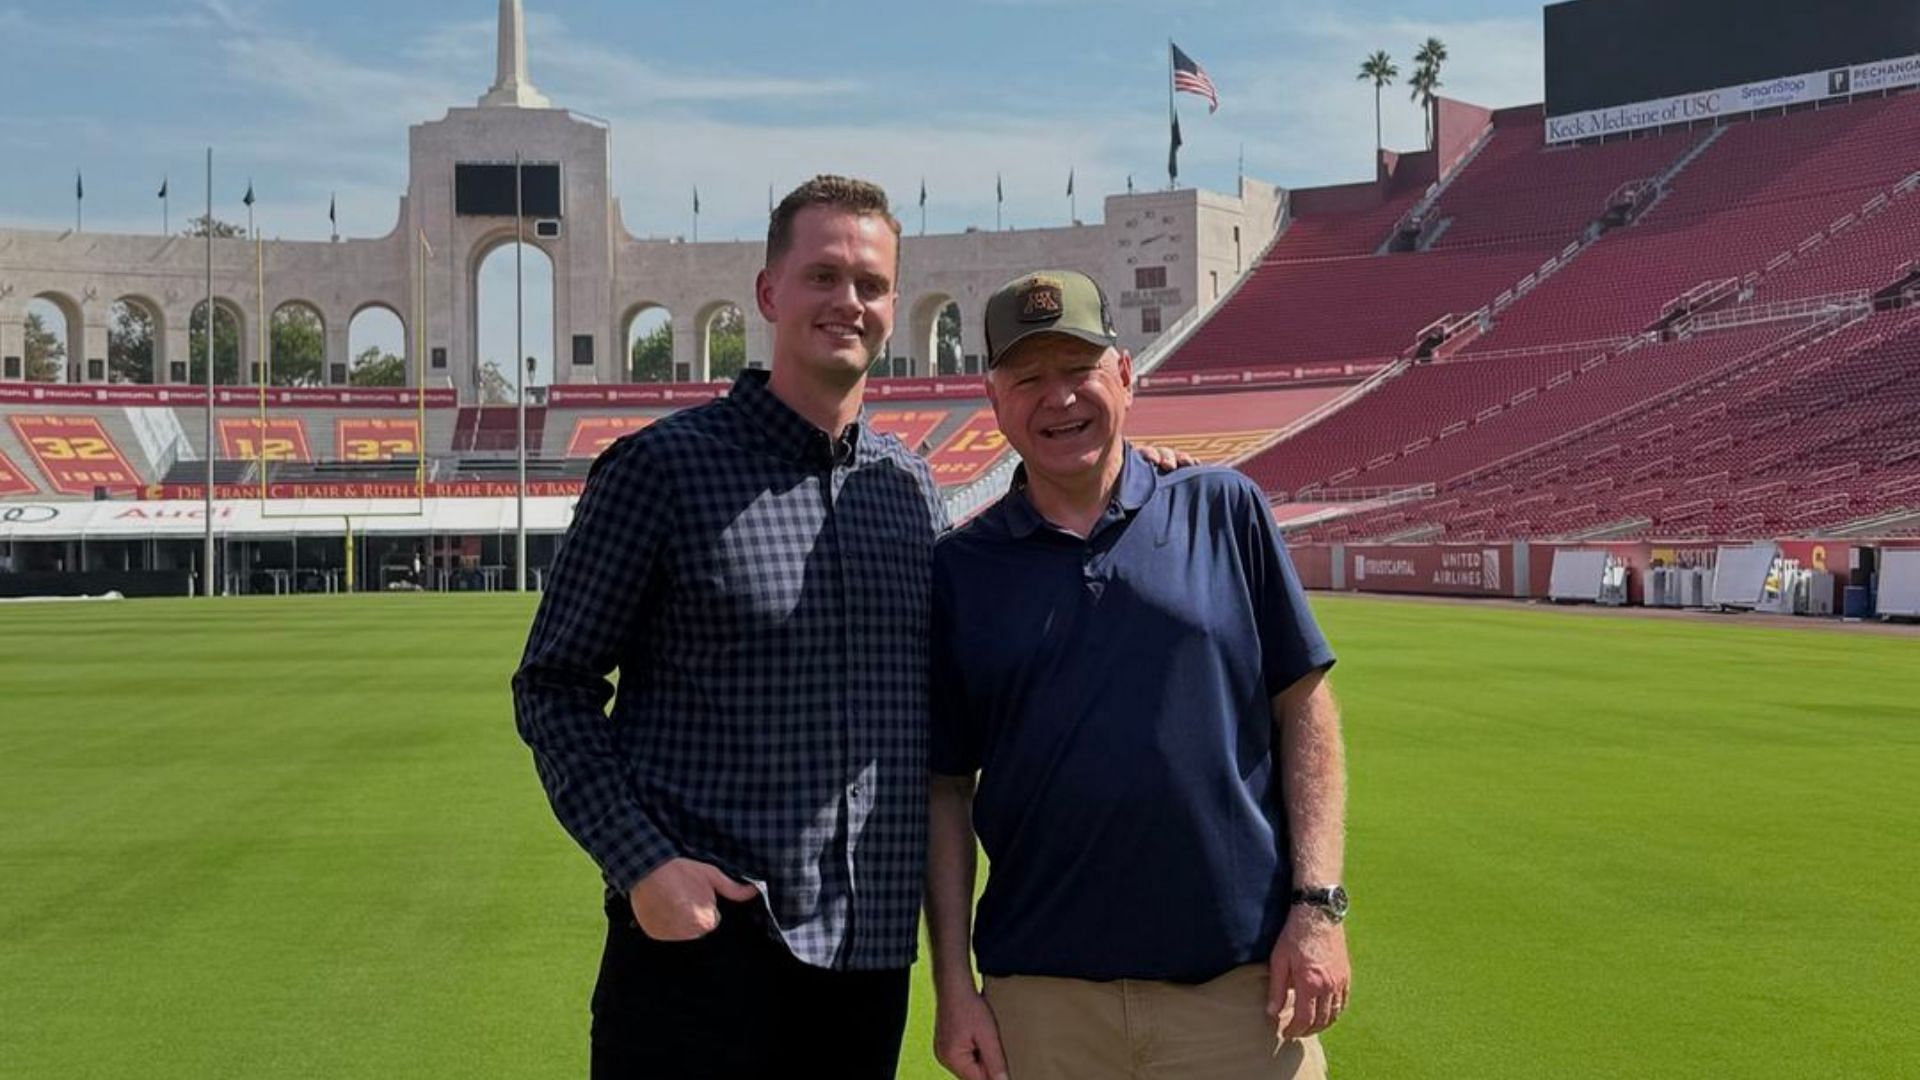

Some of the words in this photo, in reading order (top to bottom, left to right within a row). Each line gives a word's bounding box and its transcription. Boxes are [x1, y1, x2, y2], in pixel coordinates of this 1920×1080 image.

[1742, 79, 1805, 99] SmartStop
[1550, 118, 1586, 139] Keck
[1590, 108, 1659, 132] Medicine
[1661, 99, 1681, 121] of
[1683, 93, 1721, 117] USC
[32, 436, 117, 460] 32
[236, 438, 296, 459] 12
[946, 429, 1008, 451] 13
[293, 485, 339, 498] BLAIR
[343, 485, 357, 498] &
[363, 484, 408, 498] RUTH
[436, 484, 480, 497] BLAIR
[1441, 552, 1480, 568] UNITED
[1432, 570, 1481, 586] AIRLINES
